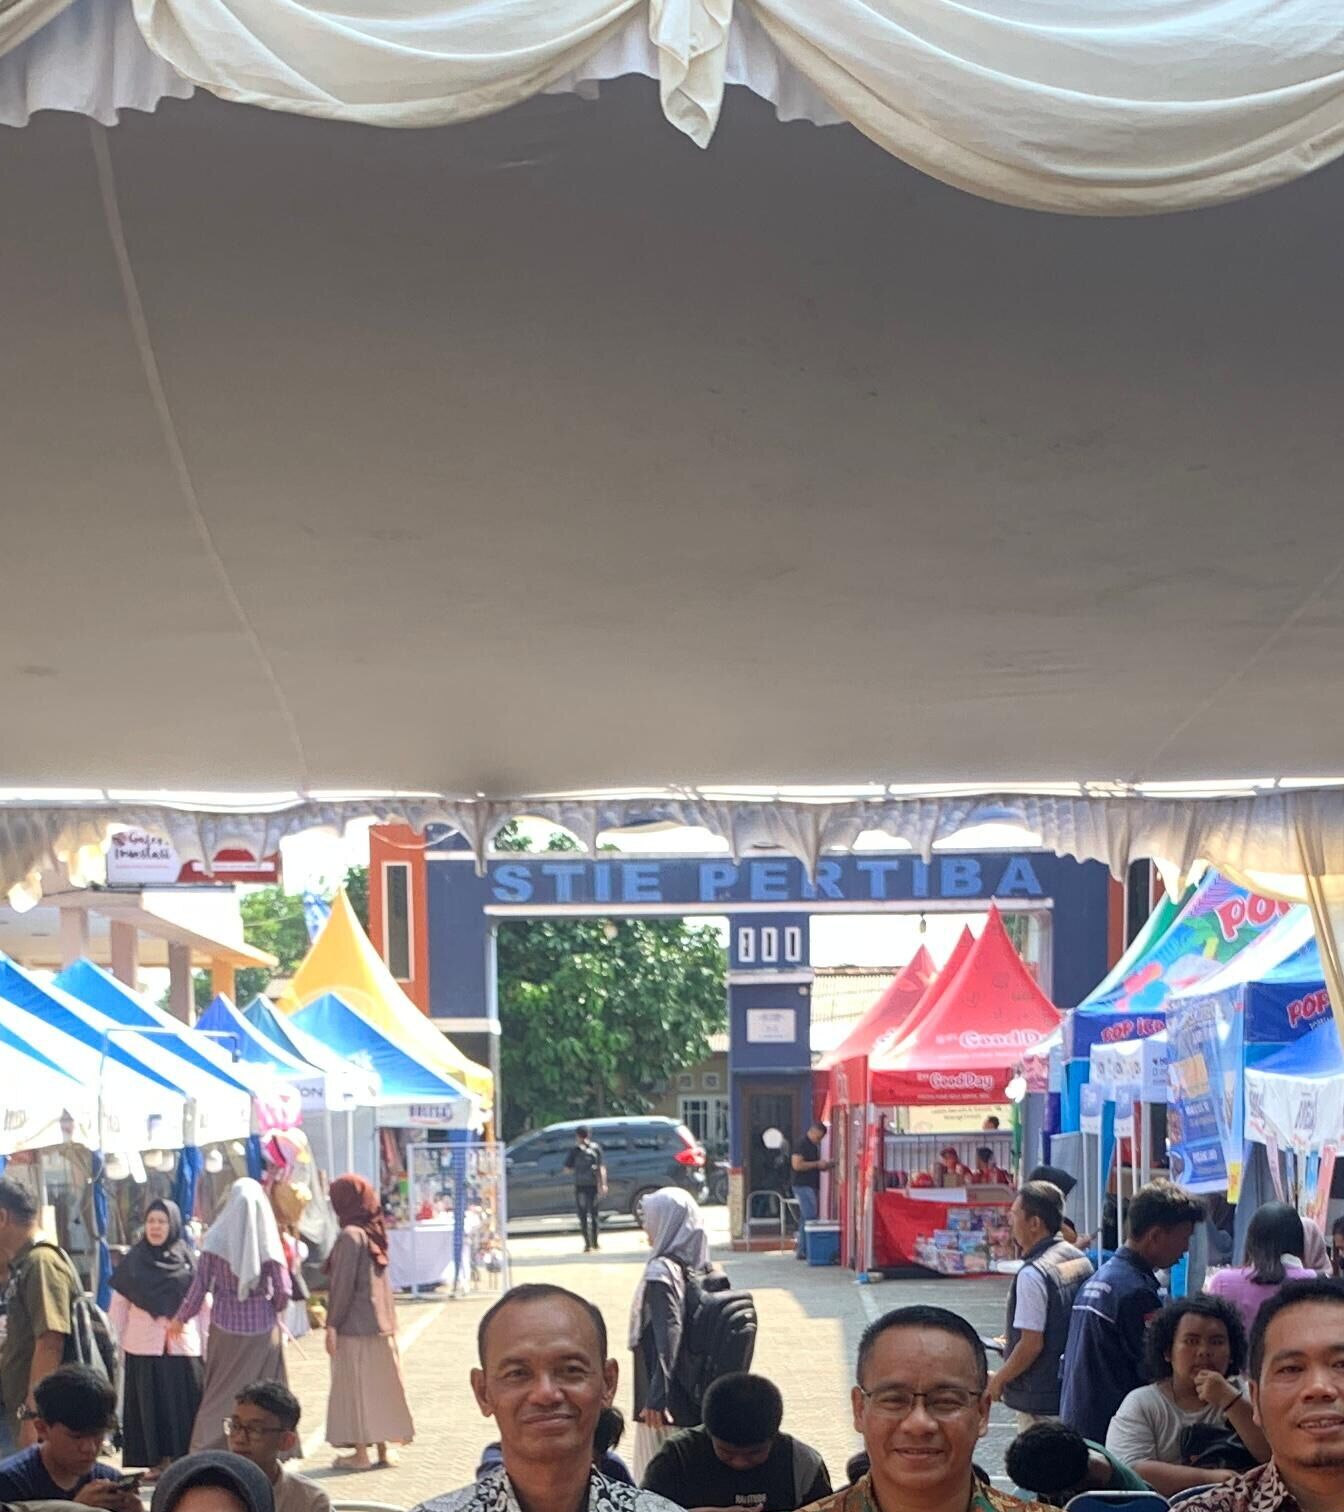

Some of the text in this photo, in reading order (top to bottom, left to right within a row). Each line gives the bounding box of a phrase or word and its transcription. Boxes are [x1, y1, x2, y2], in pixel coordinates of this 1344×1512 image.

[492, 855, 1043, 903] STIE PERTIBA
[1215, 892, 1294, 942] PO
